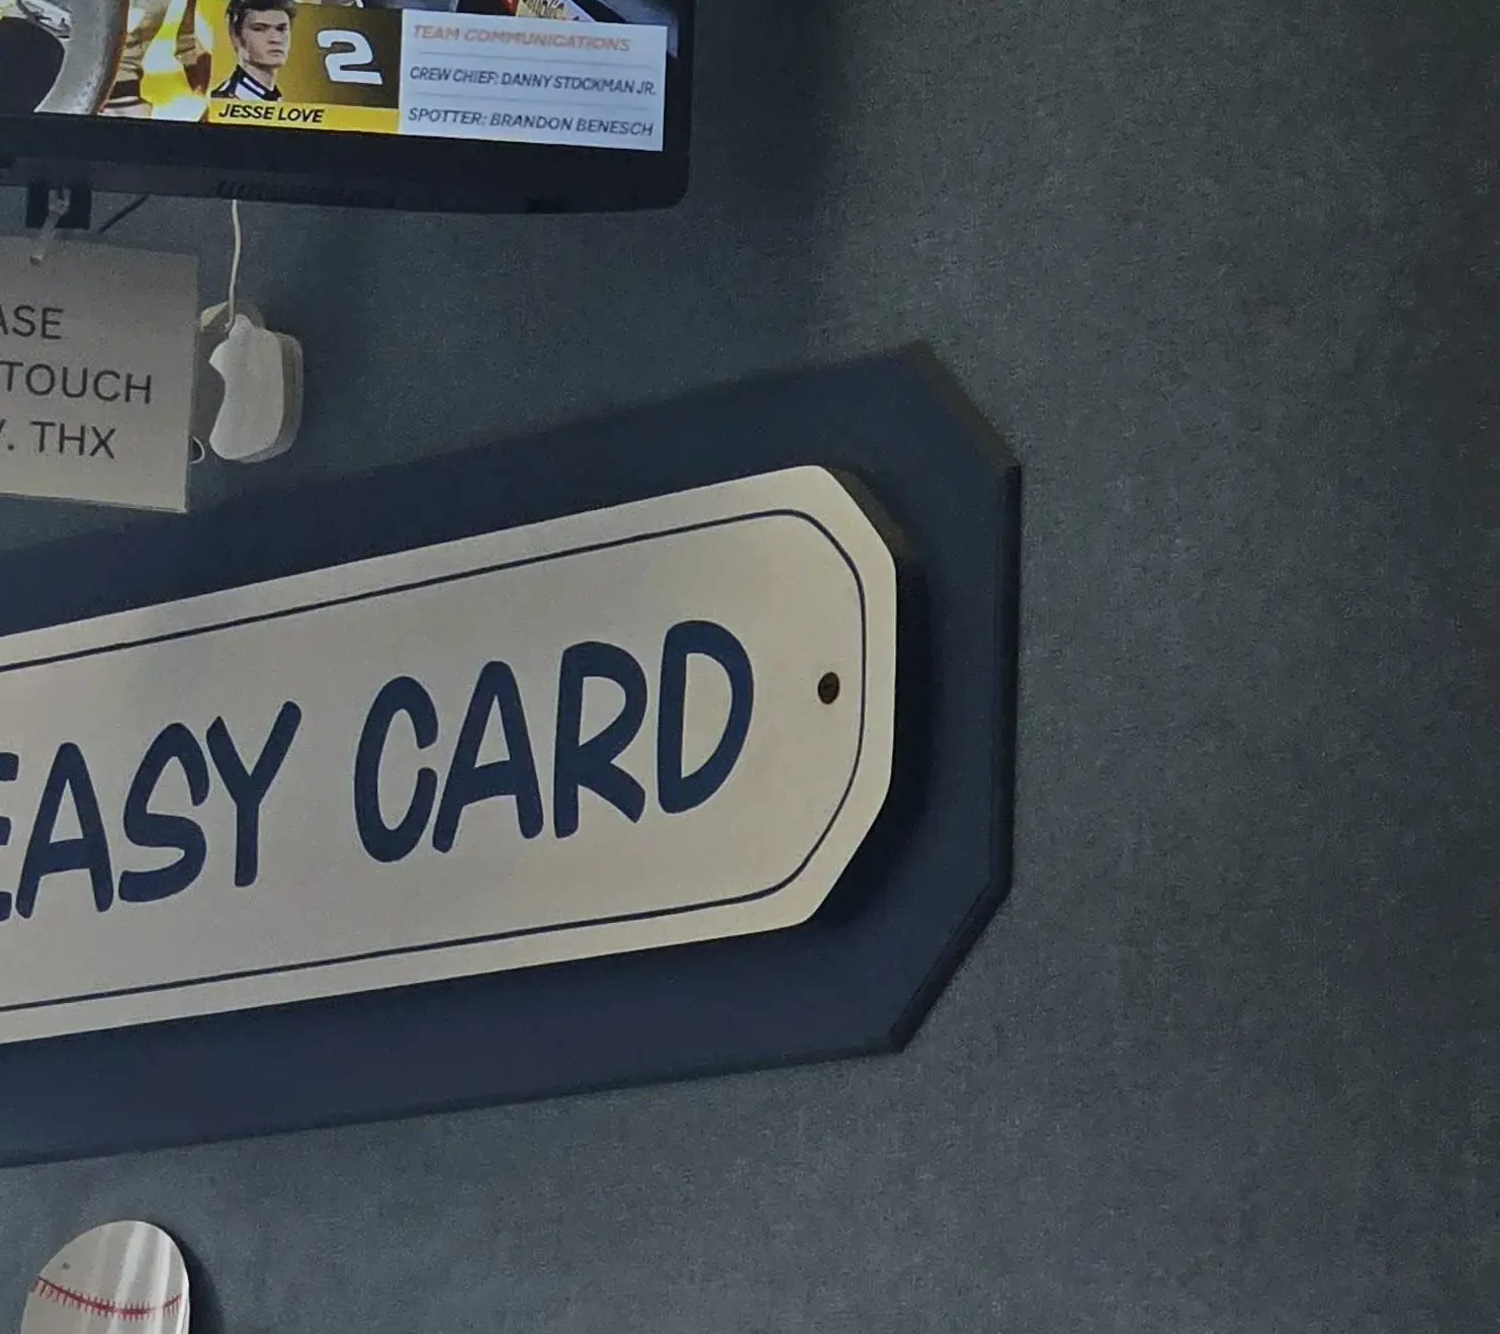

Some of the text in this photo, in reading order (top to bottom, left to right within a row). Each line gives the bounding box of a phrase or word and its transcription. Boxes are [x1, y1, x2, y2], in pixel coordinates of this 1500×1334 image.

[414, 24, 631, 52] TEAM COMMUNICATIONS
[317, 27, 383, 85] 2
[410, 66, 452, 83] CREW
[500, 73, 553, 89] DANNY
[553, 77, 636, 94] STOCKMAN
[219, 103, 324, 123] JESSE LOVE
[408, 107, 654, 136] SPOTTER: BRANDON BENESCH
[0, 360, 152, 405] TOUCH
[29, 420, 117, 460] THX
[352, 618, 755, 864] CARD
